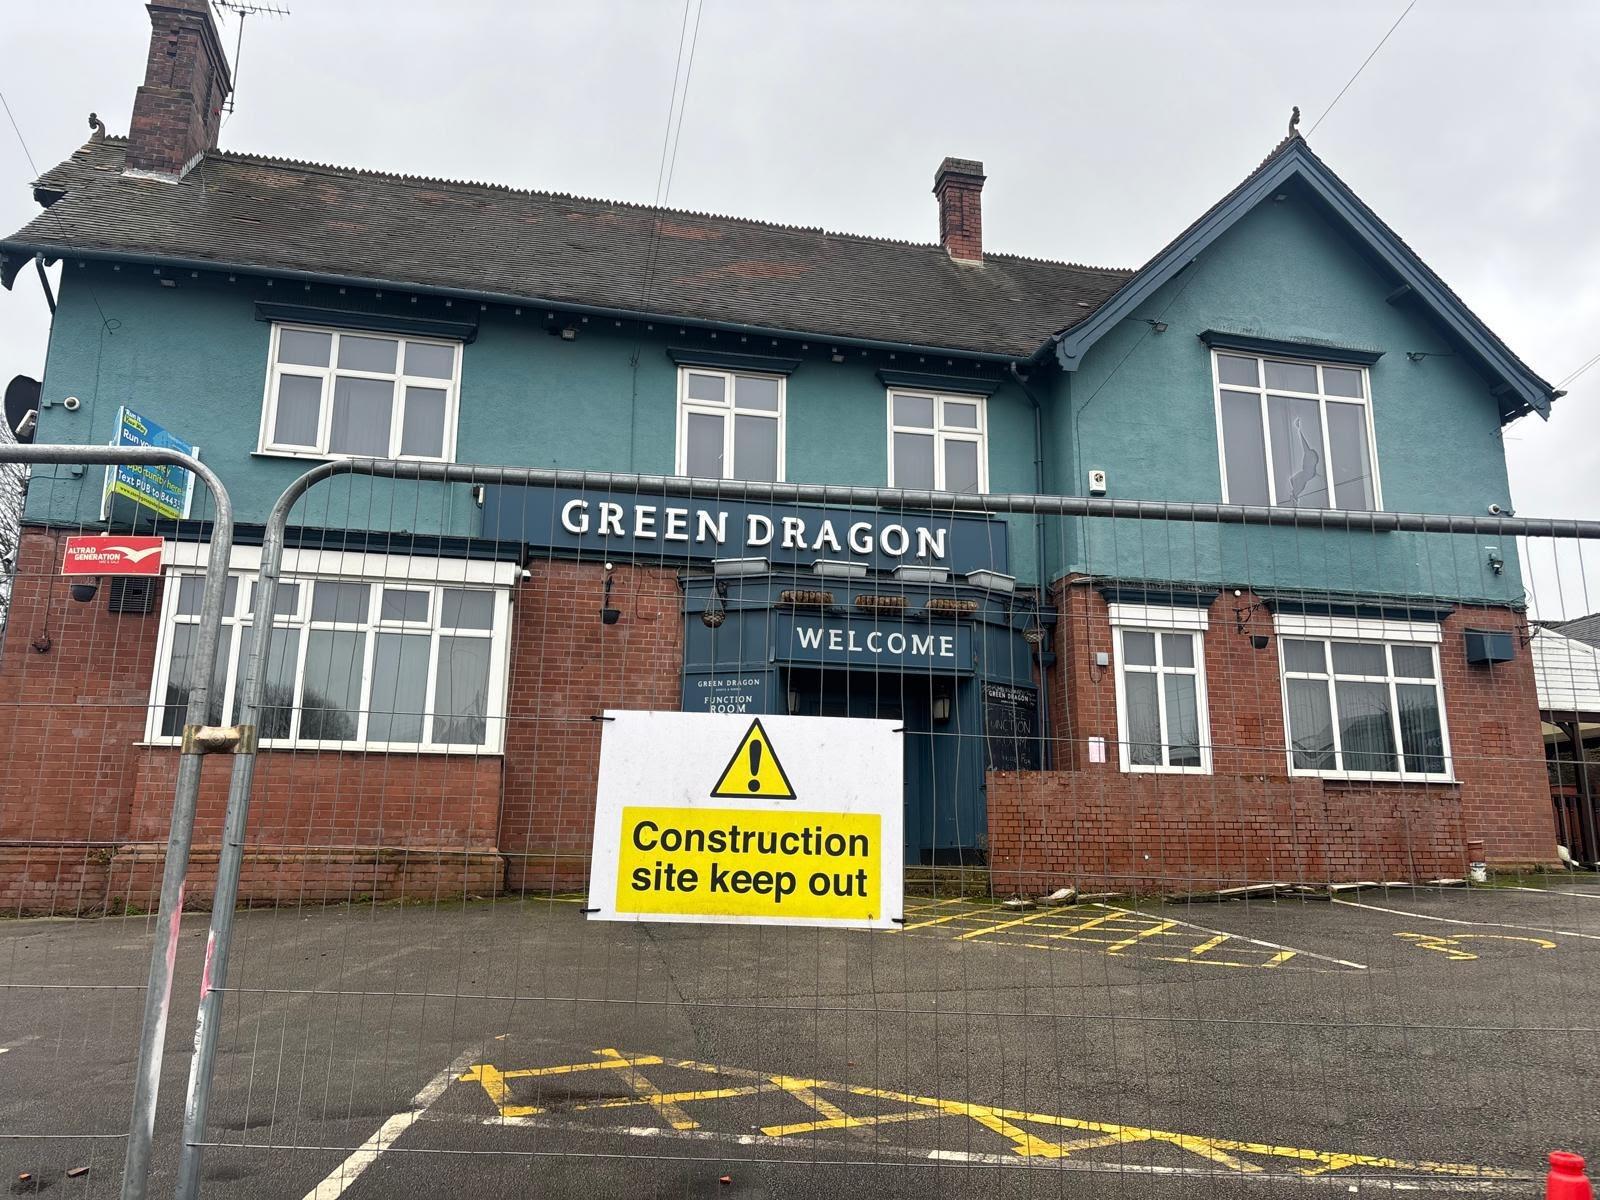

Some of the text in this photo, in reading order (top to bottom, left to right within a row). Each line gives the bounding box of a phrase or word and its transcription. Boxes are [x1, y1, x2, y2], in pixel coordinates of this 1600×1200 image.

[123, 428, 139, 445] Run
[118, 469, 135, 486] Text
[136, 479, 151, 494] PUB
[152, 488, 160, 498] to
[561, 498, 948, 560] GREEN DRAGON
[67, 546, 96, 554] ALTRAD
[74, 553, 120, 561] GENERATION
[796, 626, 955, 658] WELCOME
[704, 696, 752, 704] FUNCTION
[988, 690, 1006, 699] GREEN
[1007, 693, 1029, 702] DRAGON
[711, 704, 746, 713] ROOM
[633, 820, 869, 857] Construction
[631, 861, 868, 903] site keep out
